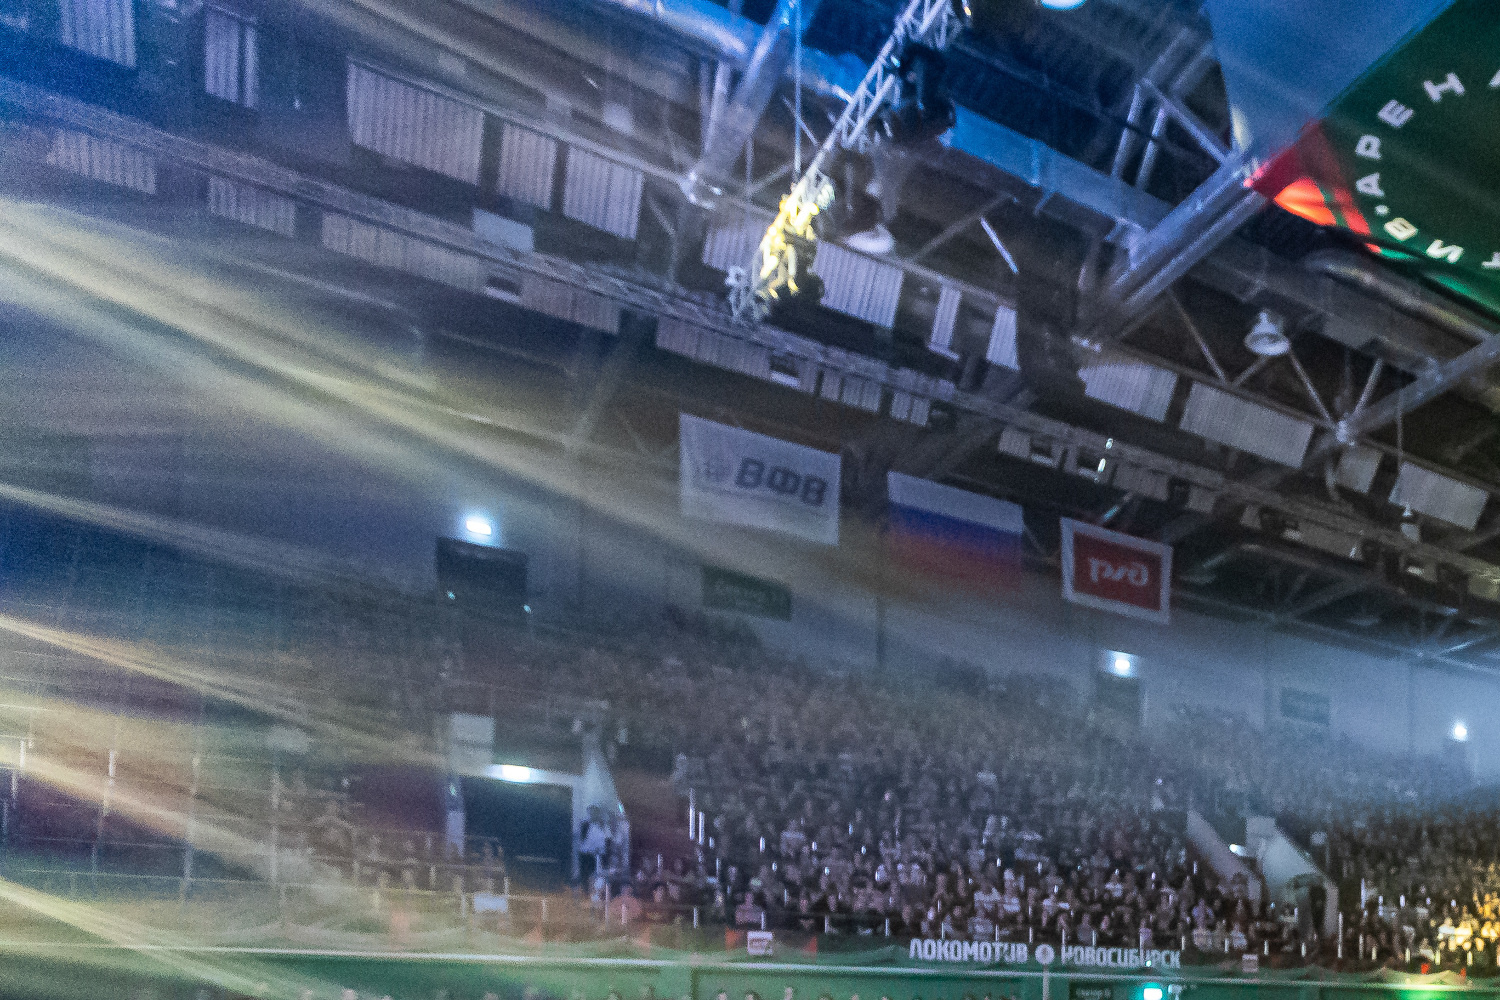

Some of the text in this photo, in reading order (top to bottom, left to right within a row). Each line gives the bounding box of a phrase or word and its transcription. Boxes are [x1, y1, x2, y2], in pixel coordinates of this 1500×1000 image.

[735, 456, 829, 508] ВФВ
[909, 937, 1181, 969] ЛОКОМОТИВ НОВОСИБИРСК
